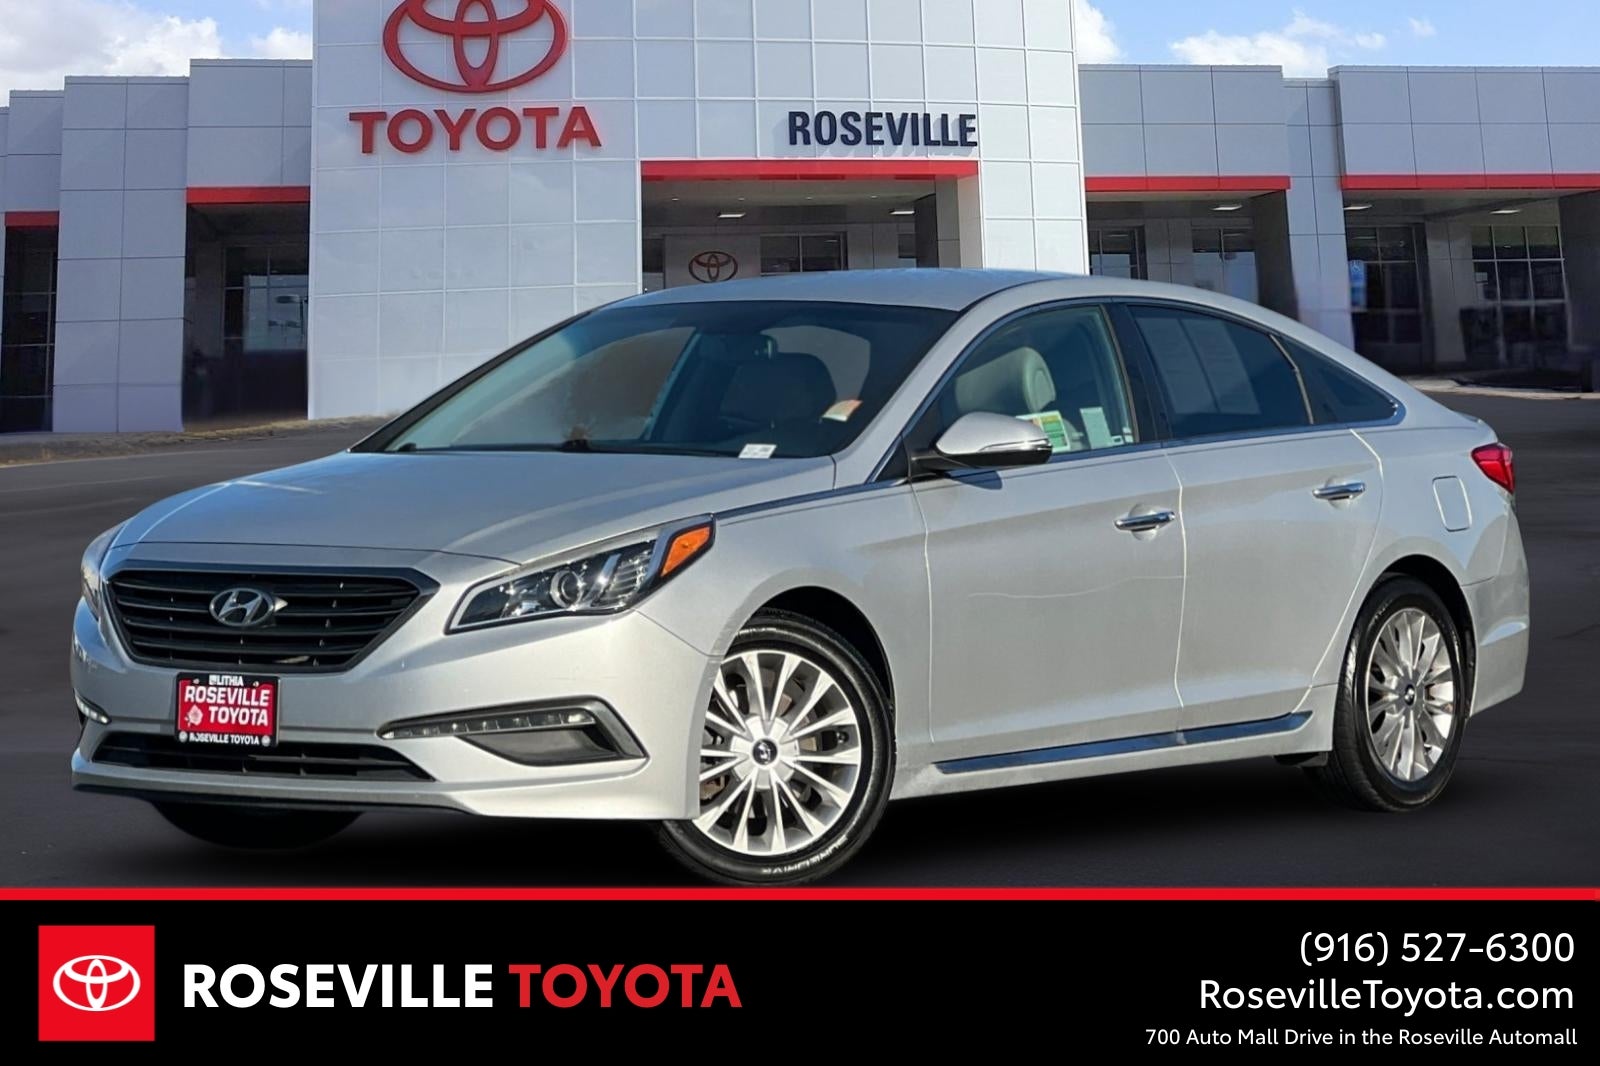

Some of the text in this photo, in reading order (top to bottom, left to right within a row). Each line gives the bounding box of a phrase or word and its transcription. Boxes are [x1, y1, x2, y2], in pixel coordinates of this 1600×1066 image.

[349, 106, 602, 154] TOYOTA
[788, 111, 978, 146] ROSEVILLE
[217, 675, 244, 687] LITHIA
[184, 685, 271, 707] ROSEVILLE
[208, 706, 268, 726] TOYOTA
